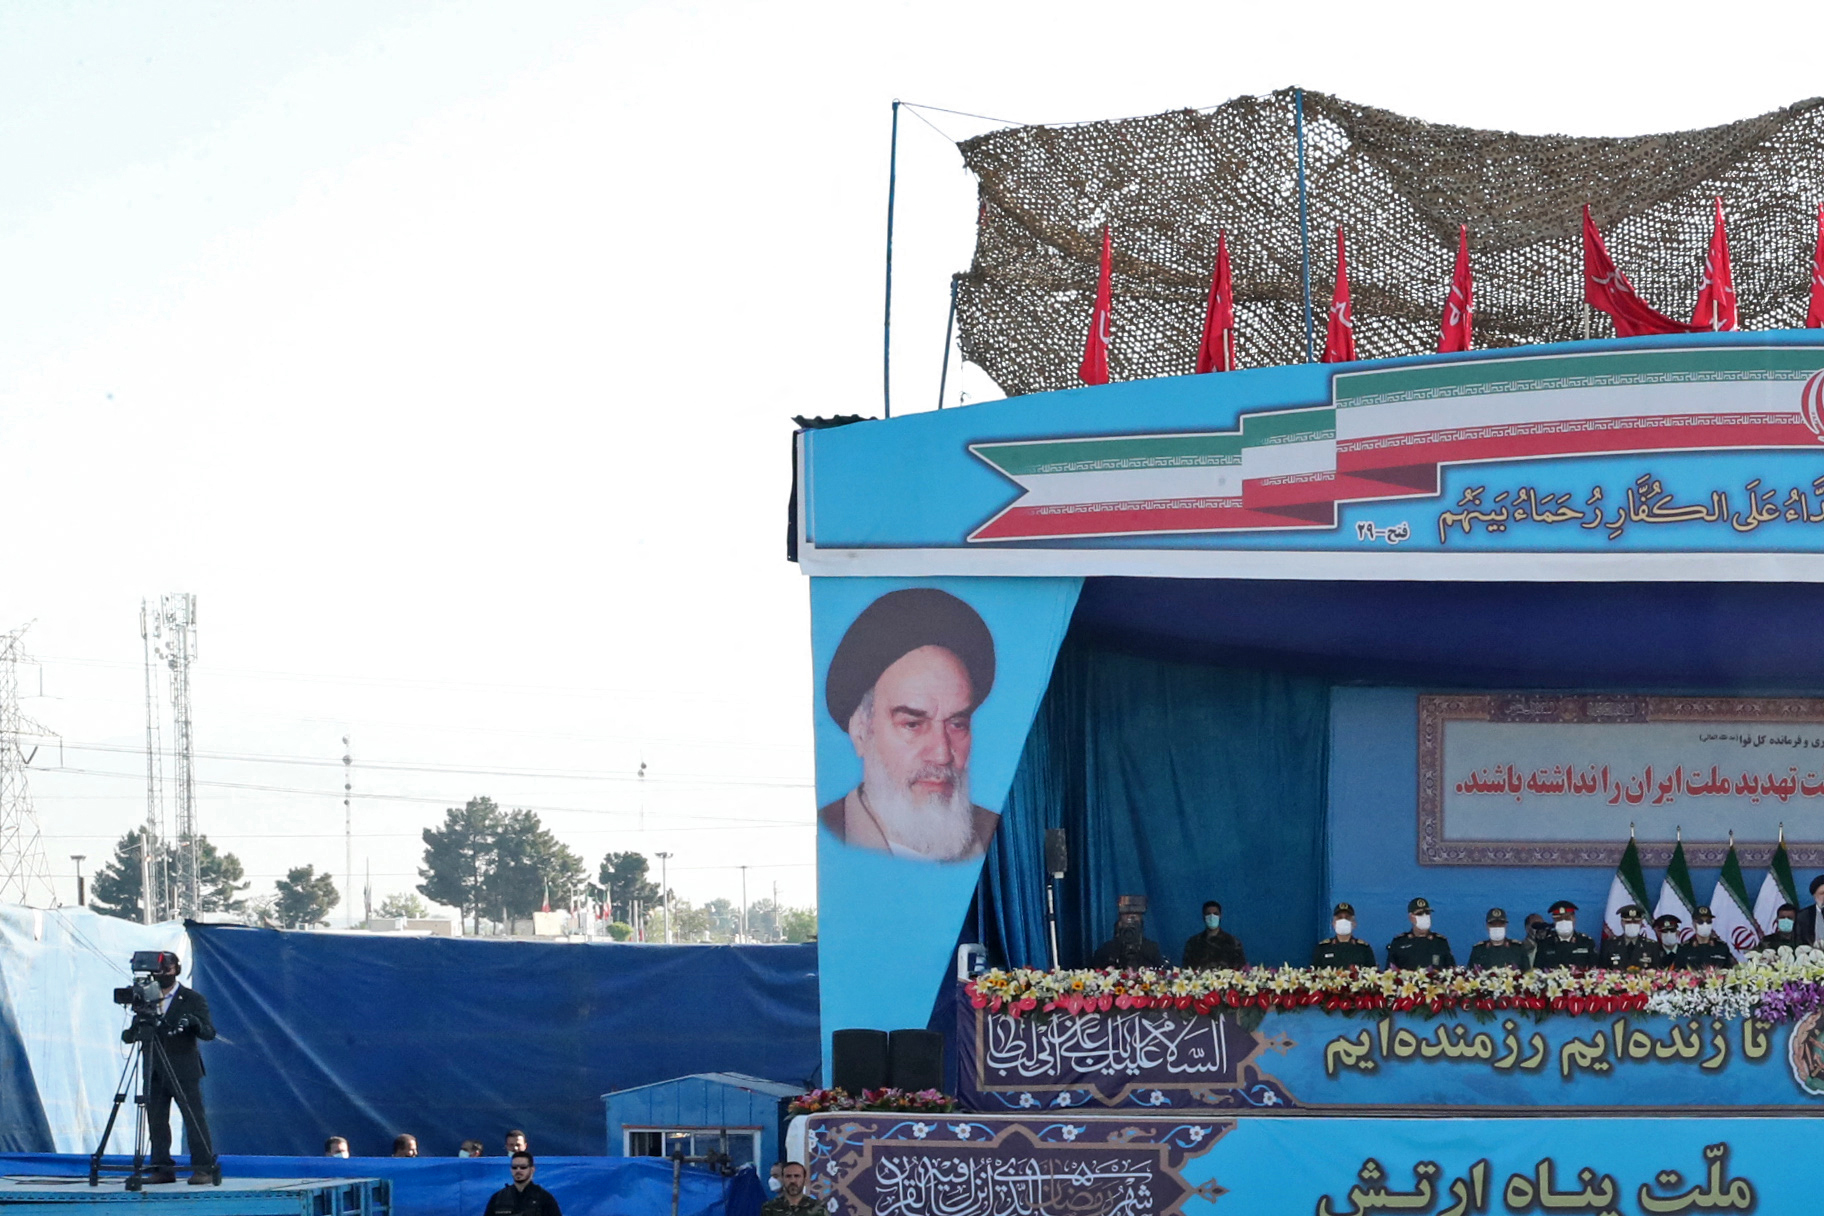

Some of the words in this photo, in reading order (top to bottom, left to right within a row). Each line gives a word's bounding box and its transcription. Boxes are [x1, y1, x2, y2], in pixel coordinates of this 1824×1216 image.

[1753, 734, 1767, 747] کل
[1769, 735, 1802, 749] فرمانده
[1454, 763, 1524, 803] باشند.
[1525, 763, 1598, 797] نداشته
[1600, 763, 1622, 806] را
[1624, 763, 1682, 806] ایران
[1685, 765, 1732, 797] ملت
[1735, 765, 1799, 804] تهدید
[1743, 1017, 1772, 1059] تا
